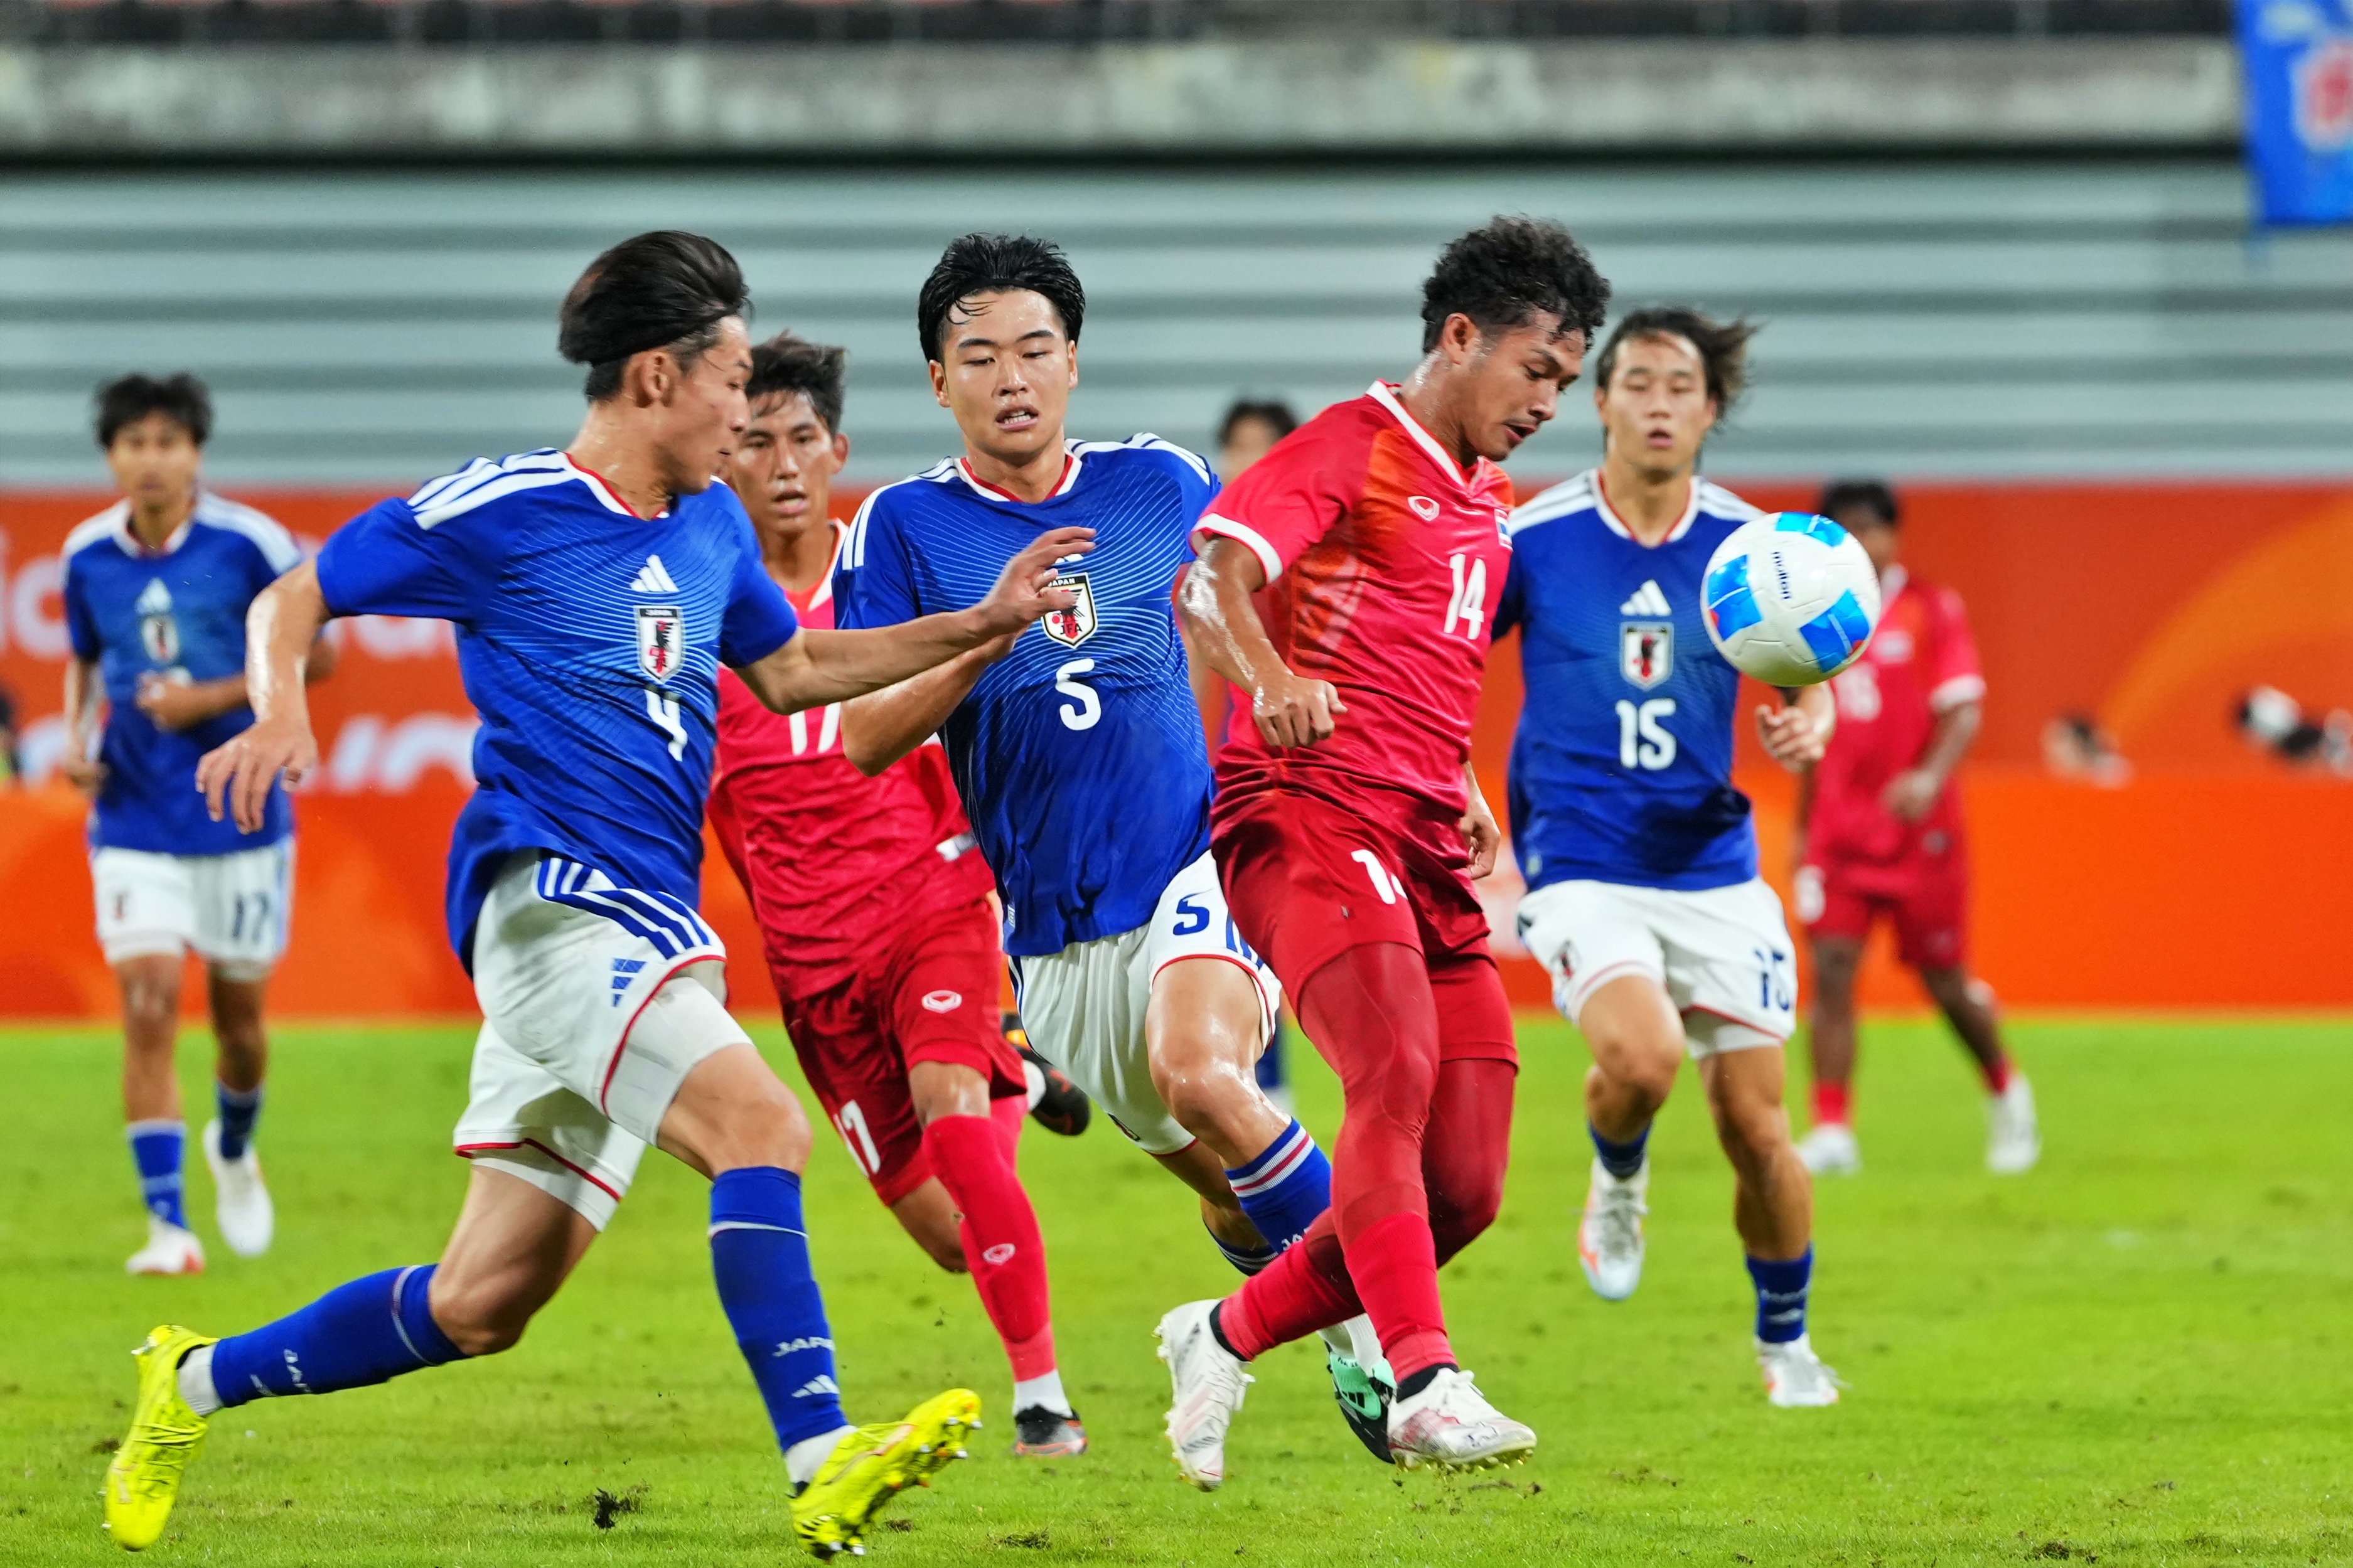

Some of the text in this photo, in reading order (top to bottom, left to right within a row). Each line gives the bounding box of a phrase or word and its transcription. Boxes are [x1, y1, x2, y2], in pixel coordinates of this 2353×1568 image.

[1059, 622, 1083, 635] JFA
[1443, 552, 1487, 640] 14
[643, 685, 689, 762] 4
[1054, 658, 1101, 731] 5
[1614, 696, 1677, 771] 15
[232, 891, 270, 946] 17
[1172, 893, 1210, 936] 5
